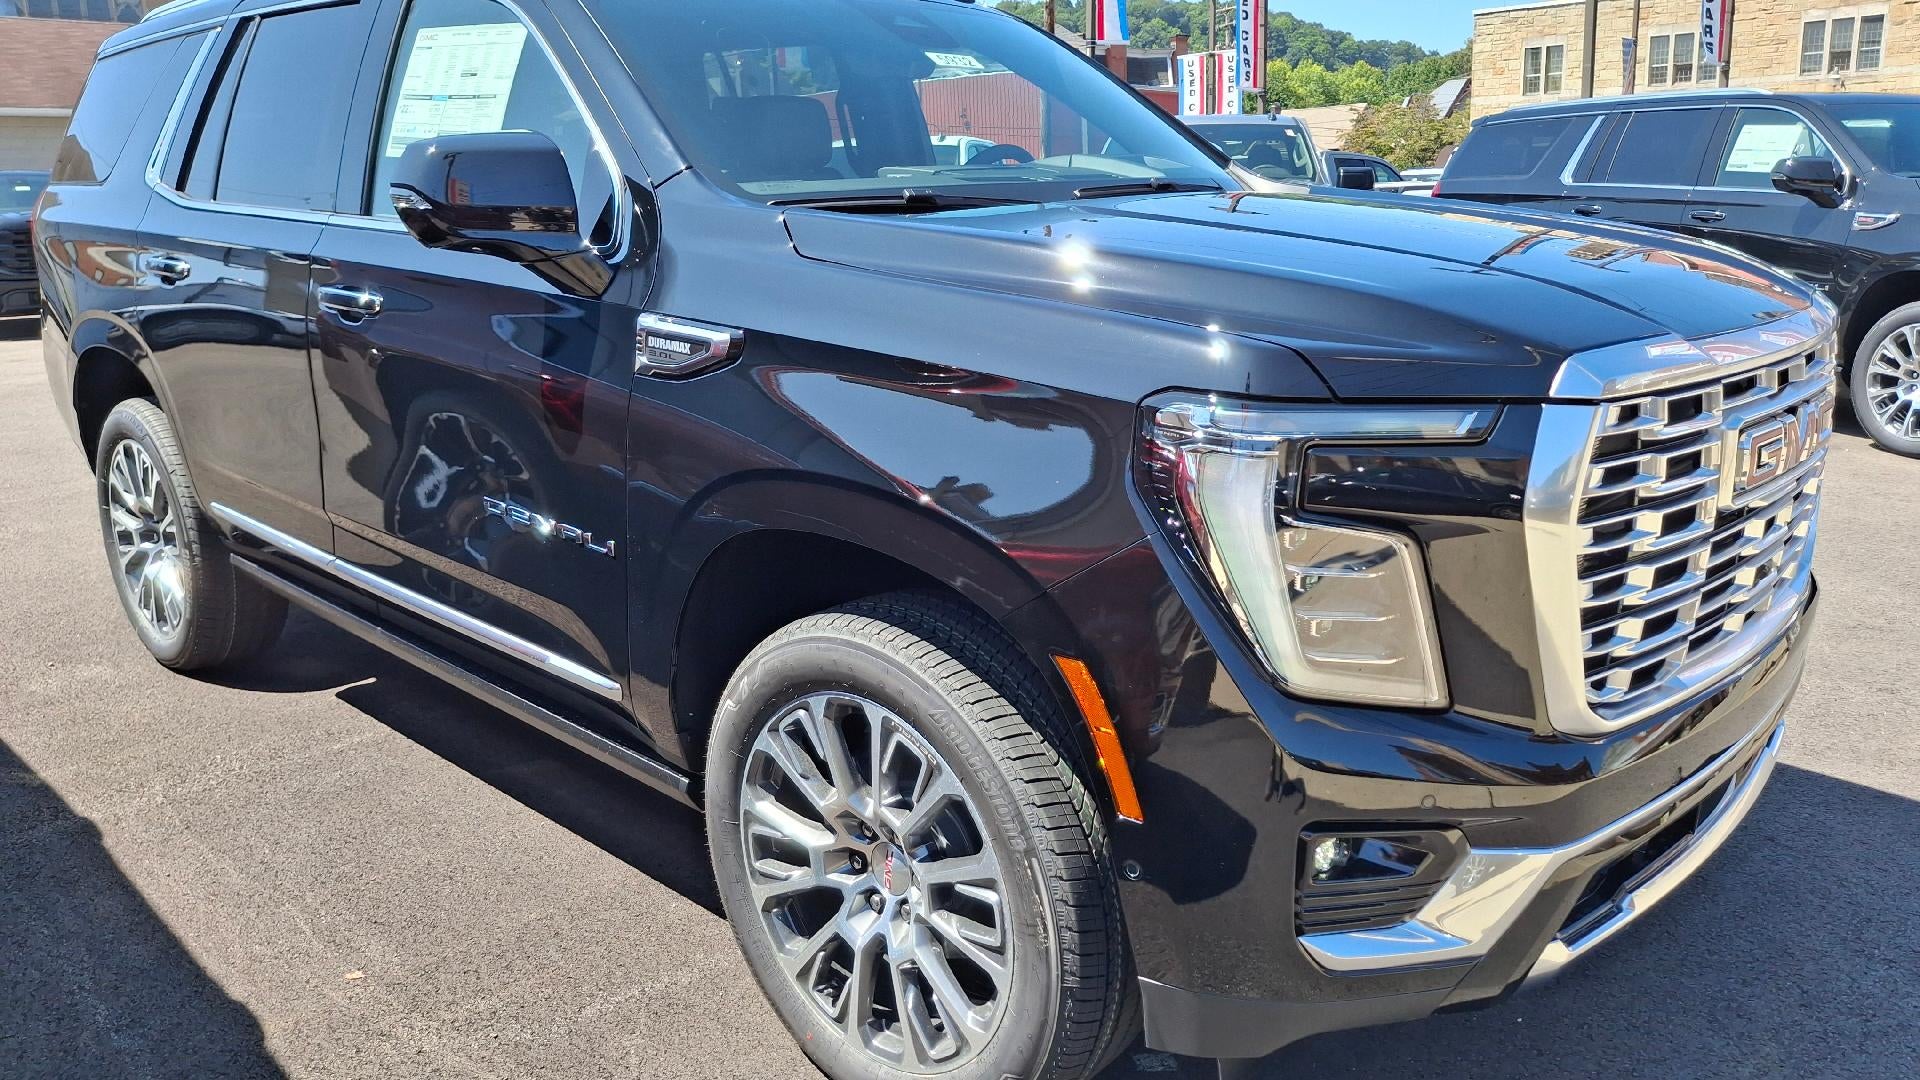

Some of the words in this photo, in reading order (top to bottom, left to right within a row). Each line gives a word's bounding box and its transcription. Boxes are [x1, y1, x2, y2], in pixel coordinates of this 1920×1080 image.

[1227, 55, 1235, 93] USED
[1241, 30, 1251, 82] CARS
[1187, 60, 1196, 97] USED
[648, 335, 691, 354] DURAMAX
[648, 349, 677, 361] 3.0L
[1744, 391, 1834, 489] GMC
[483, 496, 615, 557] DENALI
[890, 721, 937, 765] DENALI
[928, 708, 1027, 850] BRIDGESTONE
[884, 849, 894, 890] GMC
